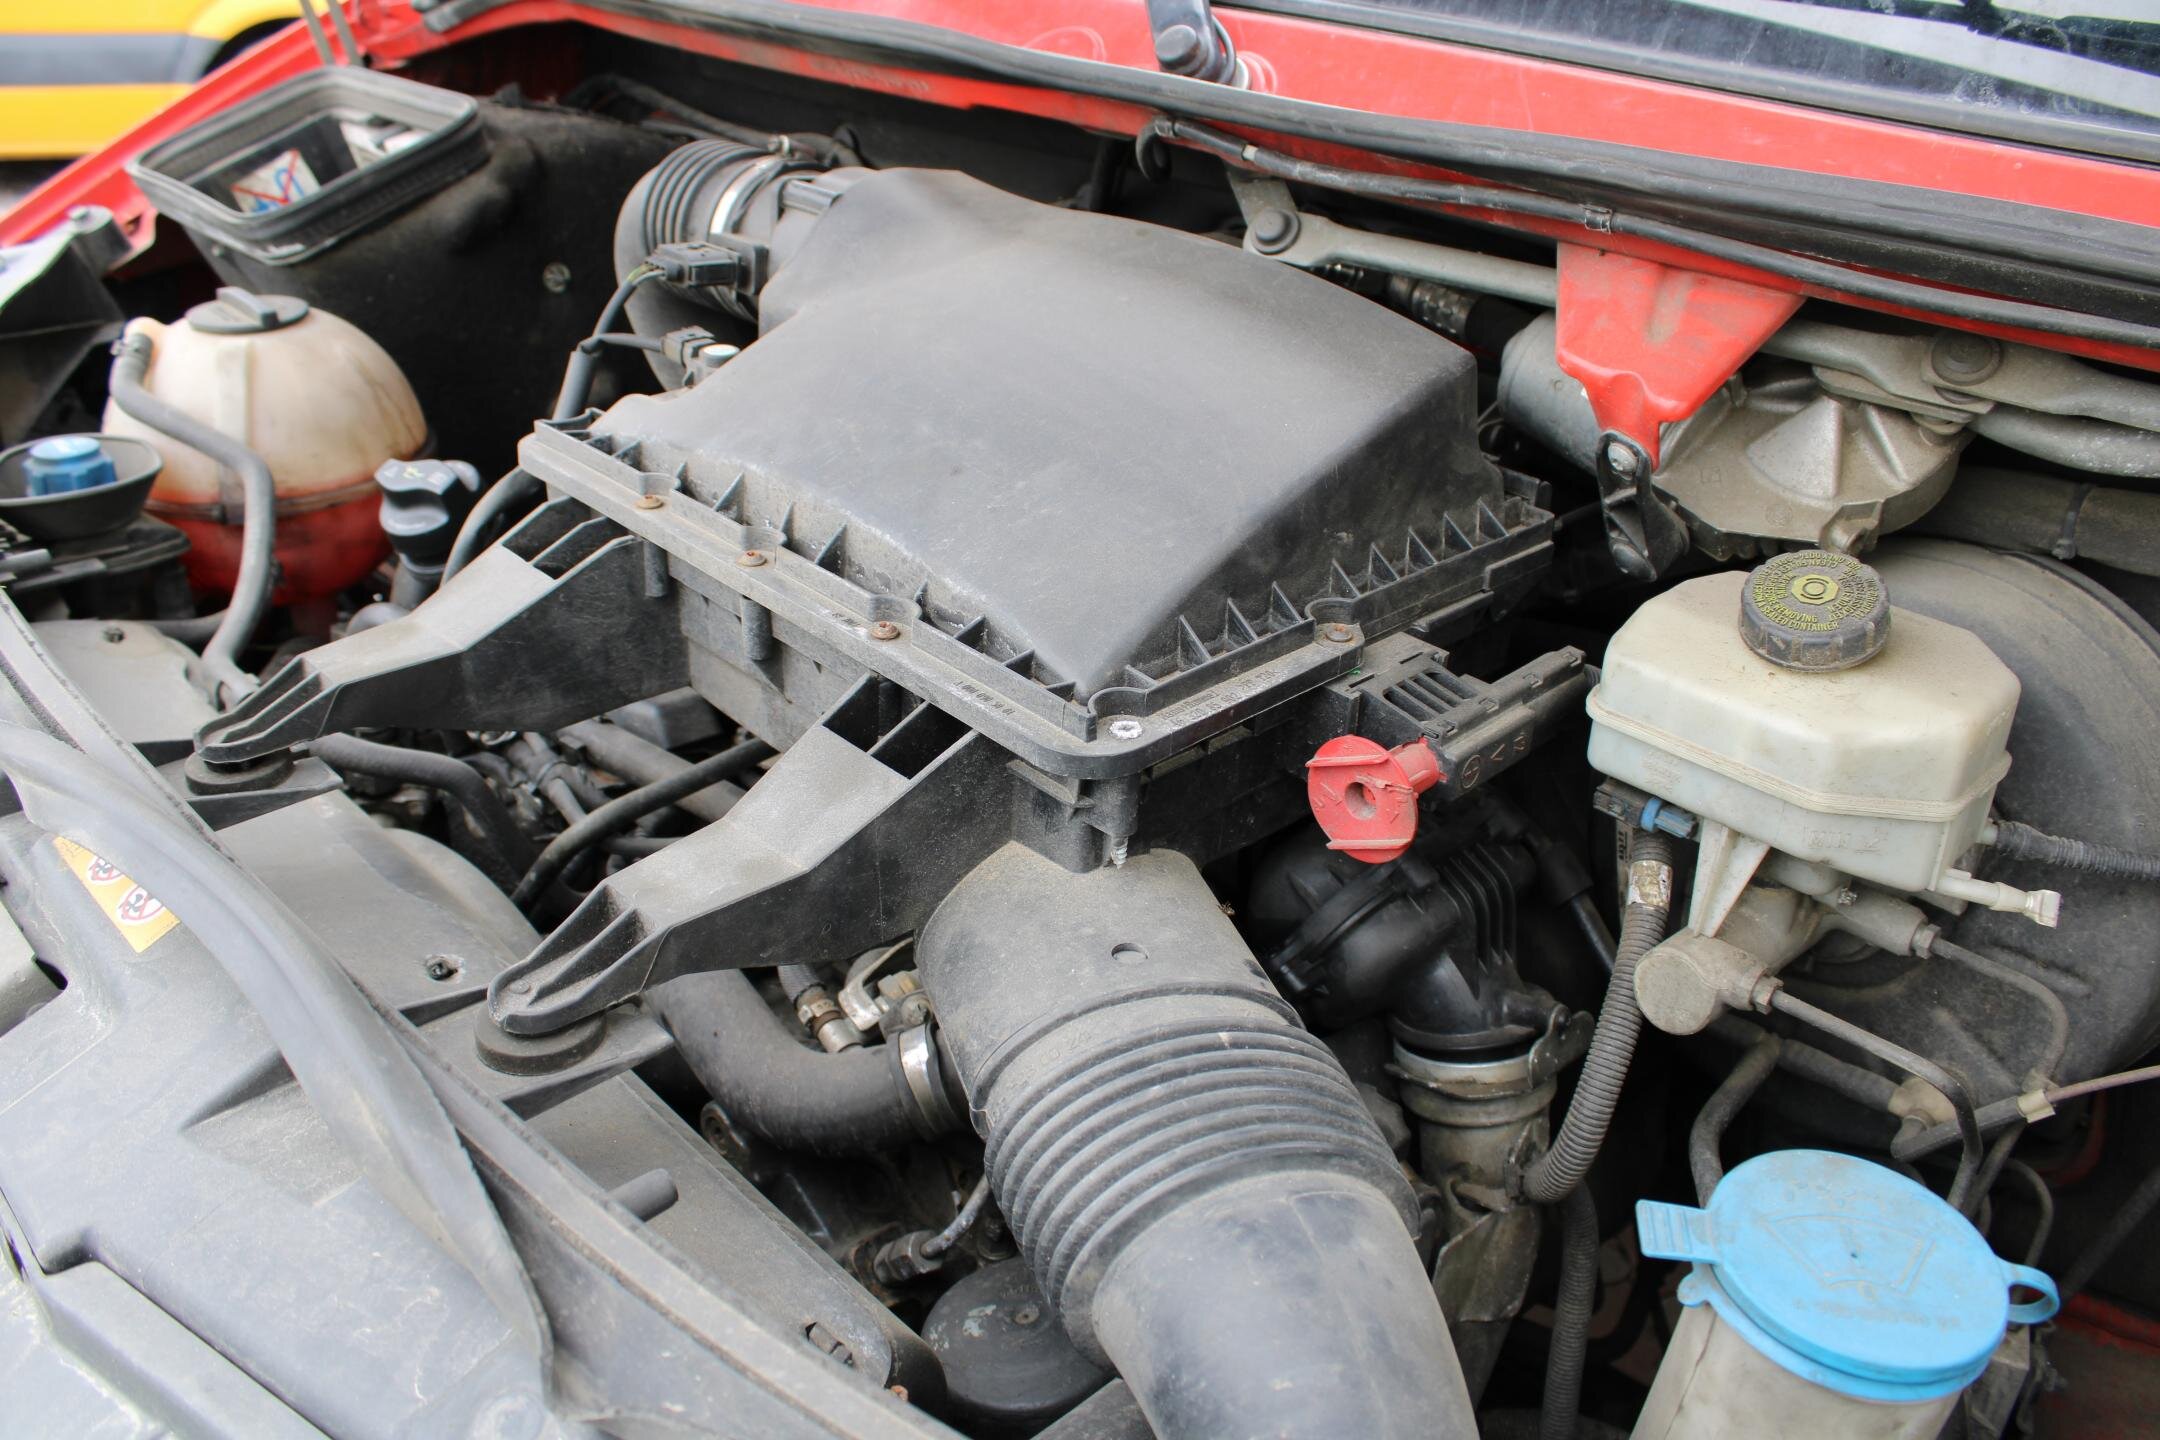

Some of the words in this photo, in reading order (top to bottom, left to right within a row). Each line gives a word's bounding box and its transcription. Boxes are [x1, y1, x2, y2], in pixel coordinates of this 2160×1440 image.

[1760, 605, 1788, 624] SEALED
[1788, 620, 1839, 631] CONTAINER
[1775, 604, 1818, 623] REMOVING
